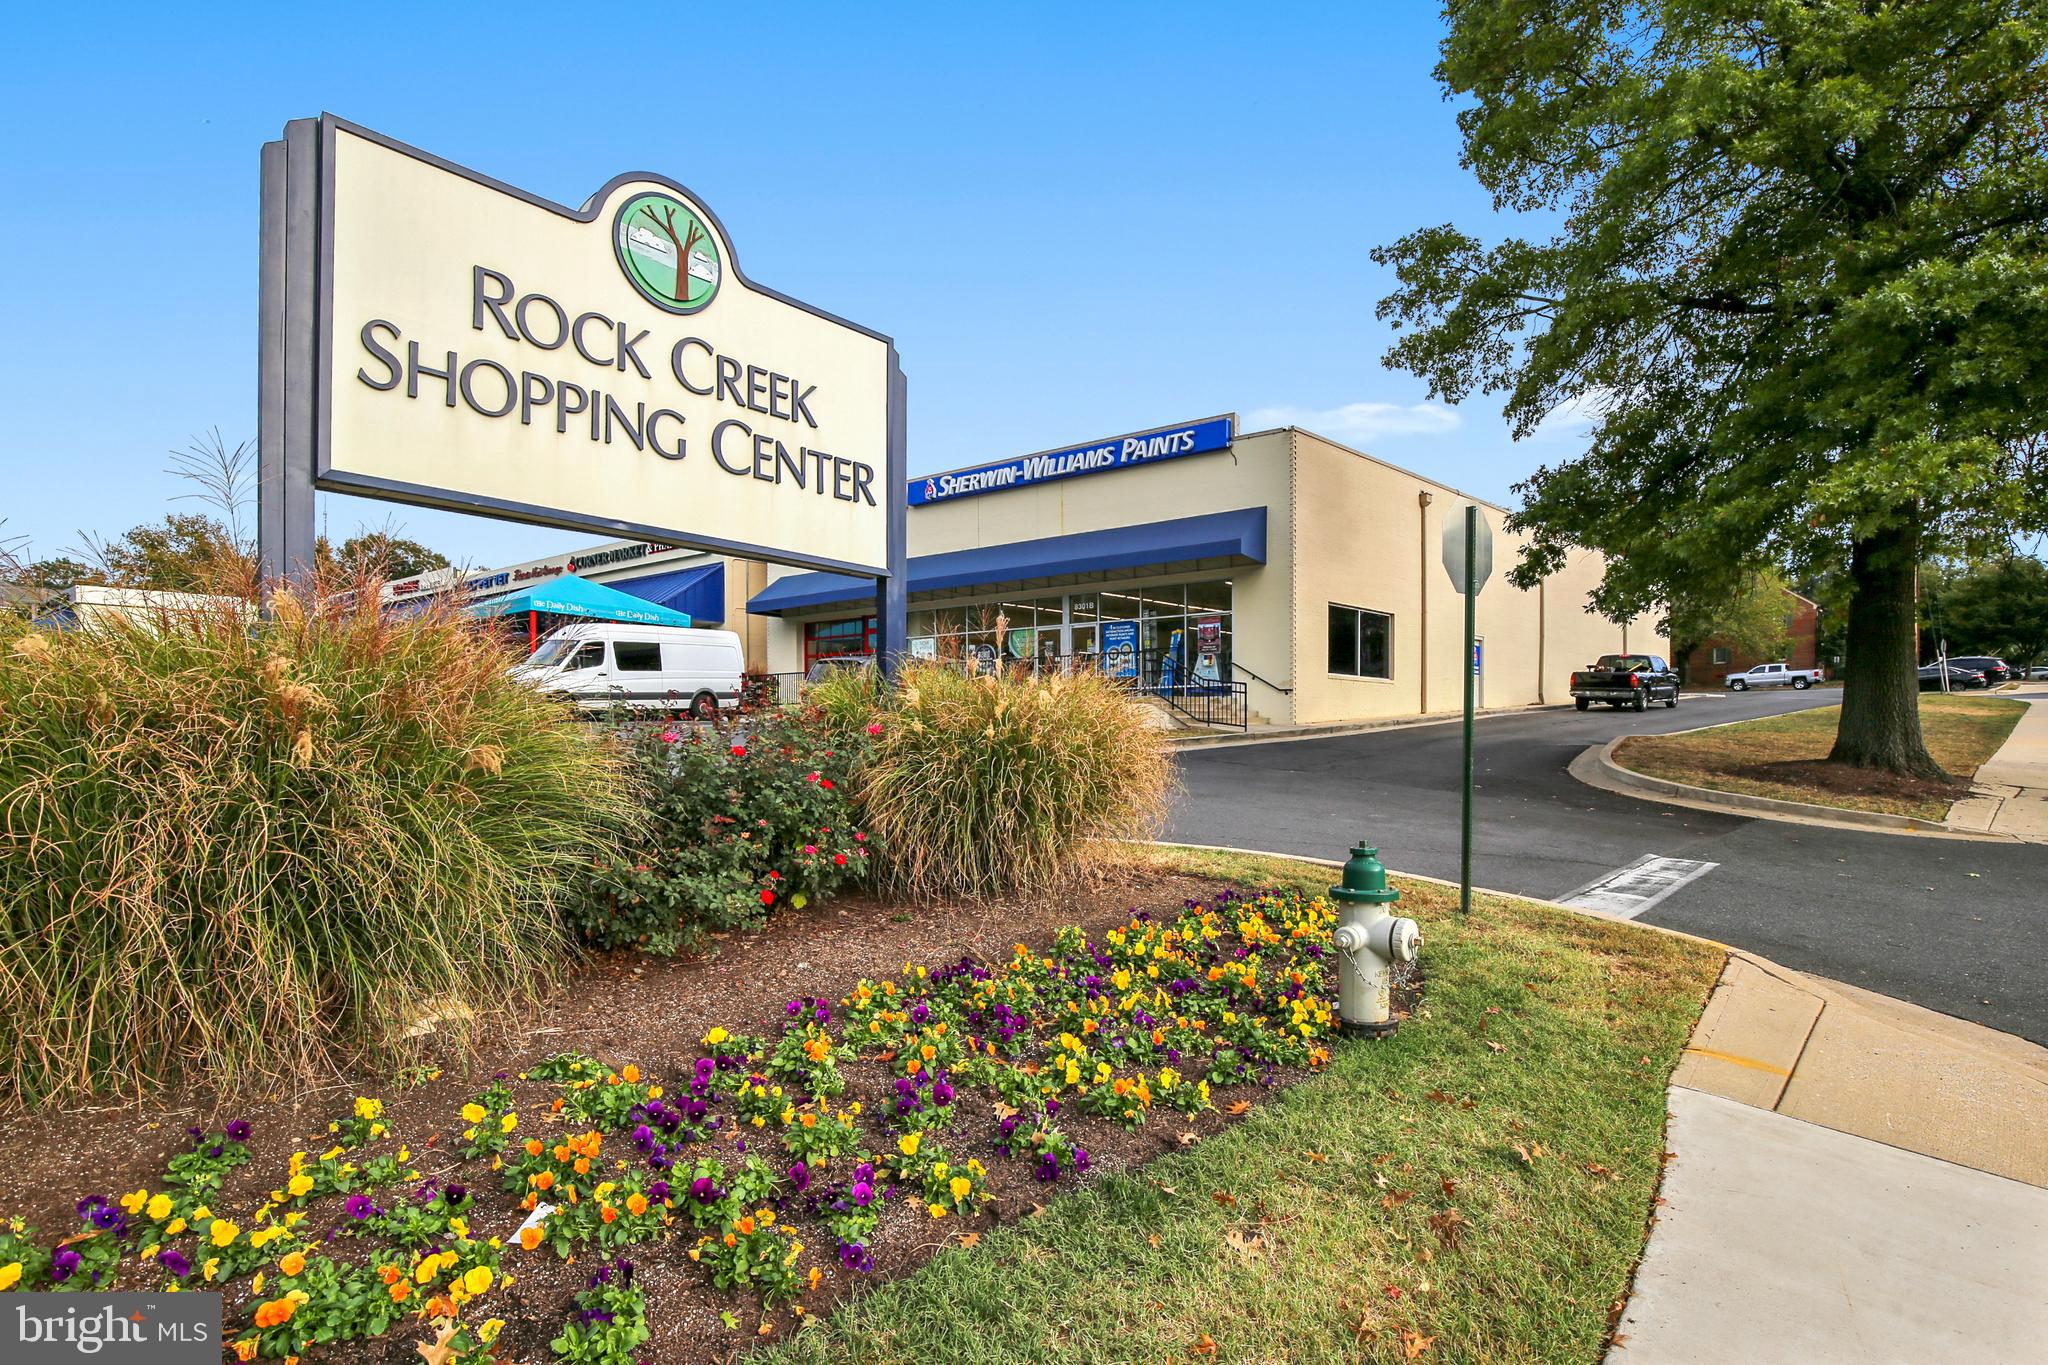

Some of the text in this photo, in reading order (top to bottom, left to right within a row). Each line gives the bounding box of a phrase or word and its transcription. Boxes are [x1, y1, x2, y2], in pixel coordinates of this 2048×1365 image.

[472, 264, 819, 429] ROCK CREEK
[357, 318, 877, 507] SHOPPING CENTER
[937, 430, 1196, 498] SHERWIN-WILLIAMS PAINTS
[546, 600, 565, 611] Daily
[566, 602, 584, 613] Dish
[627, 610, 643, 621] Daily
[644, 612, 659, 622] Dish
